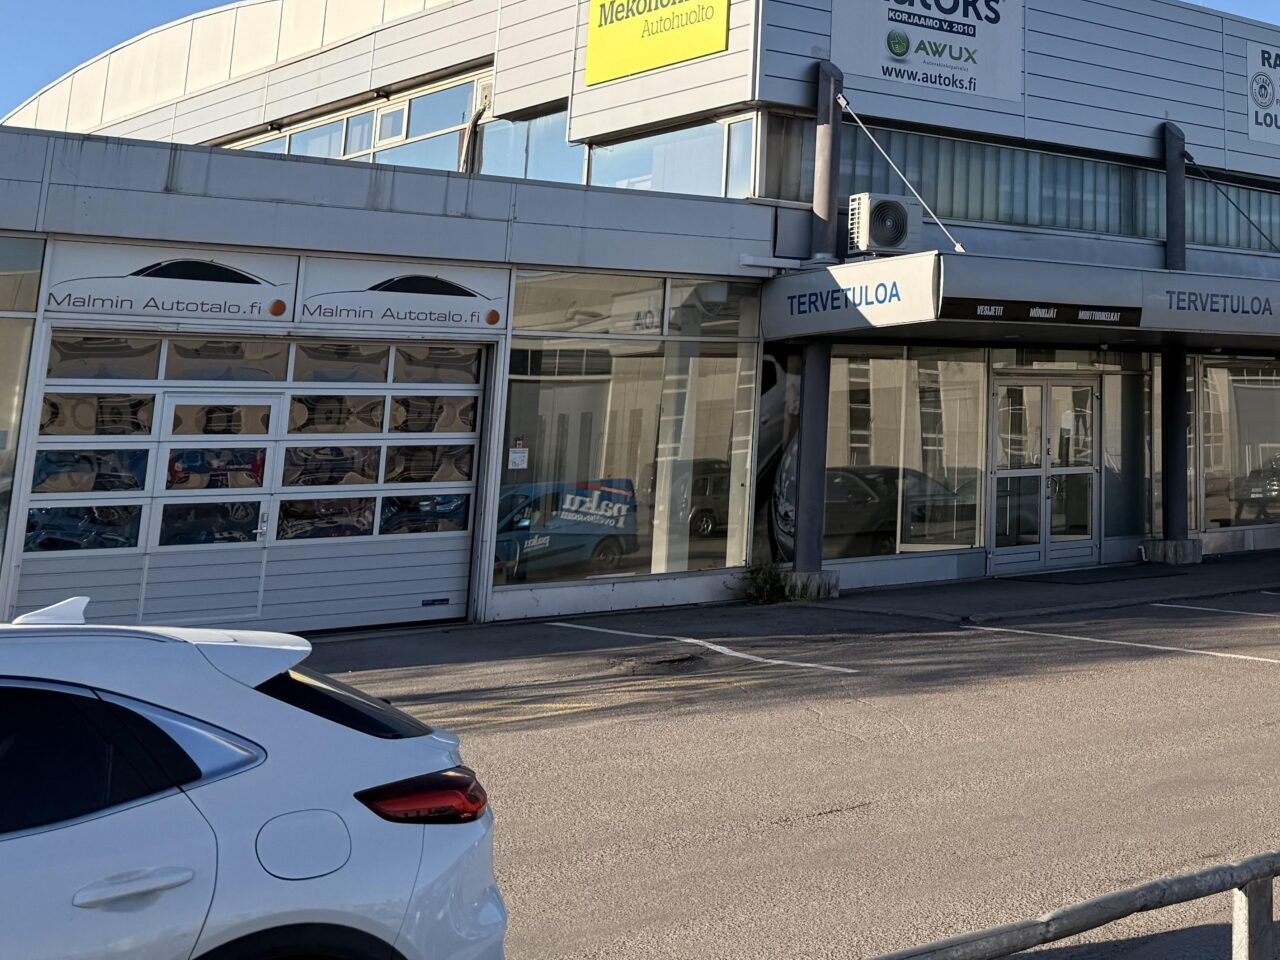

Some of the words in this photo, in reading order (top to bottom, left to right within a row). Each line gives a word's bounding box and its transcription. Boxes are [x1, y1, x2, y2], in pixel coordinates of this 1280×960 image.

[641, 5, 715, 38] Autohuolto
[888, 10, 940, 29] KORJAAMO
[942, 22, 950, 31] V.
[952, 23, 975, 35] 2010
[914, 40, 979, 65] AWUX
[882, 65, 977, 92] www.autoks.fi
[47, 292, 133, 310] Malmin
[143, 296, 262, 315] Autotalo.fi
[787, 281, 901, 316] TERVETULOA
[1166, 290, 1273, 316] TERVETULOA
[302, 303, 374, 319] Malmin
[381, 307, 480, 324] Autotalo.fi
